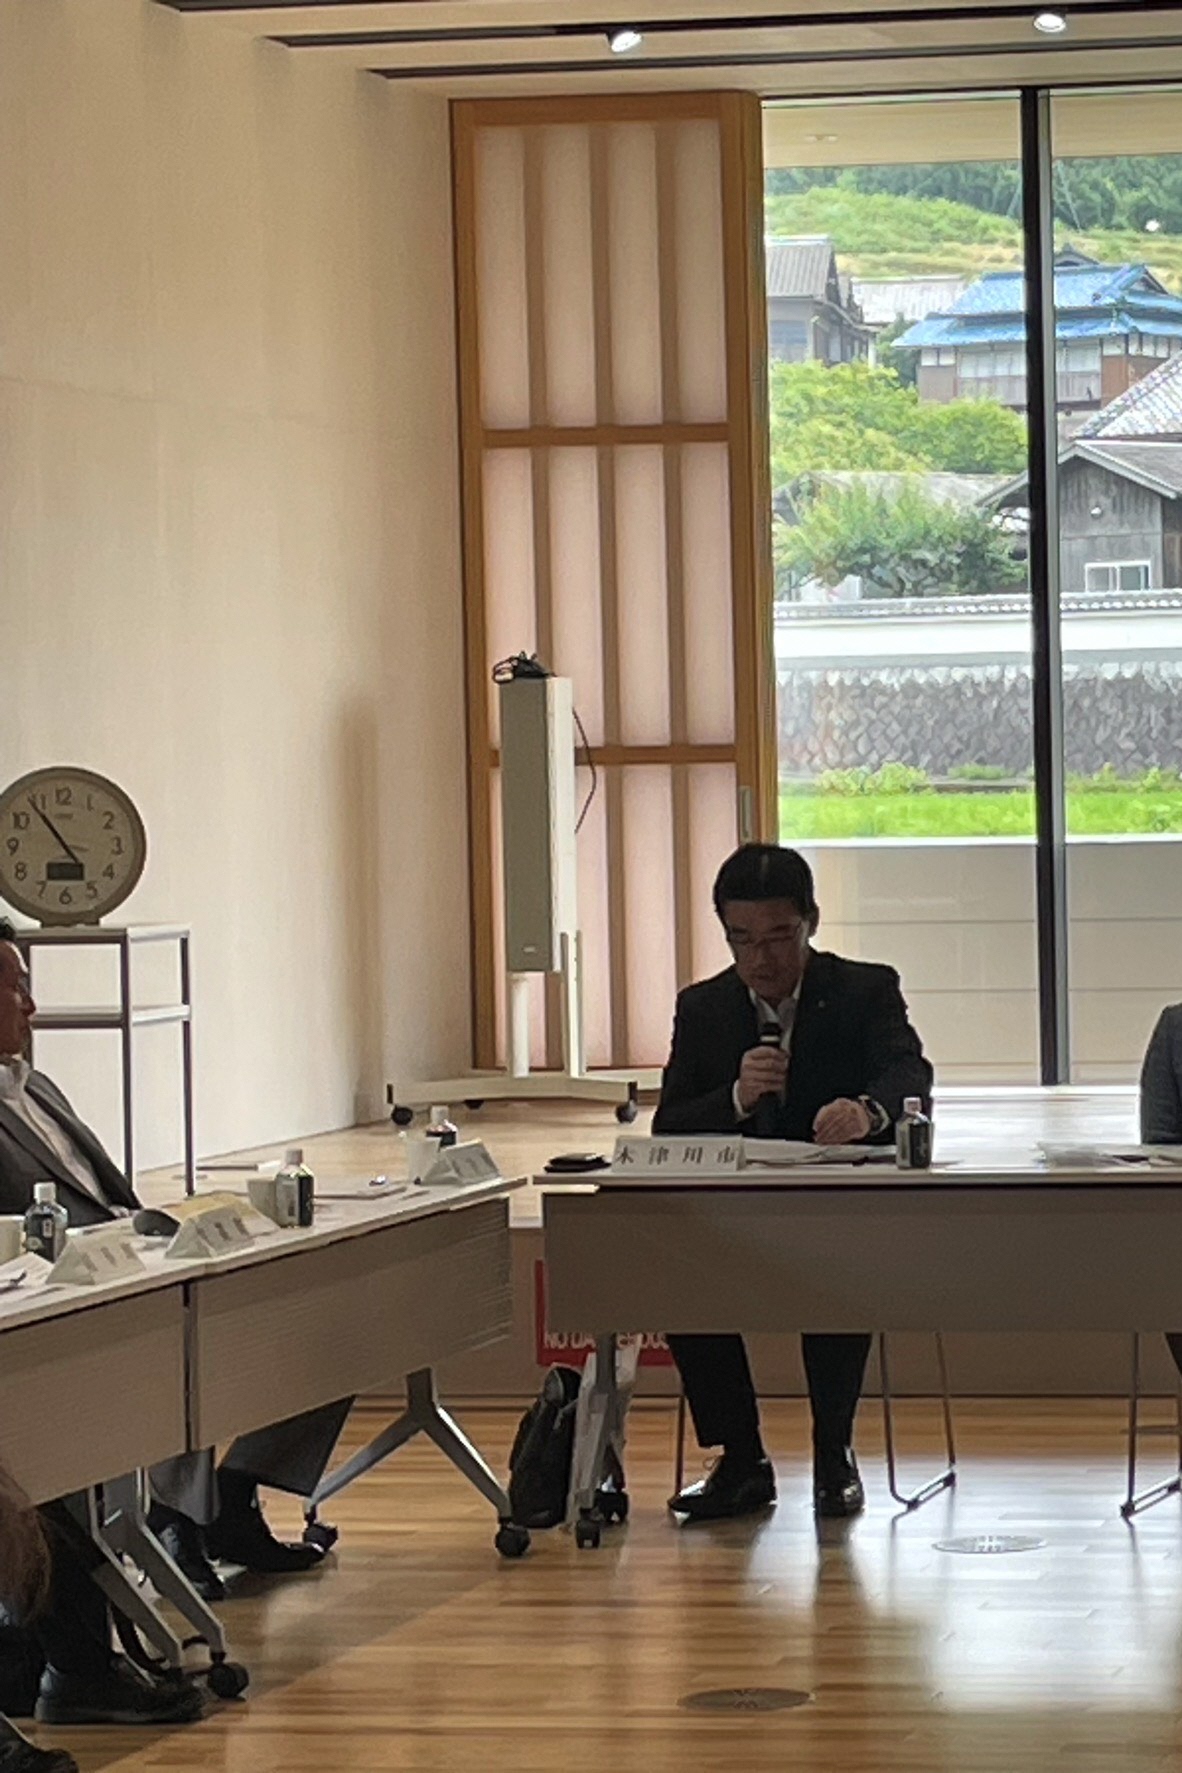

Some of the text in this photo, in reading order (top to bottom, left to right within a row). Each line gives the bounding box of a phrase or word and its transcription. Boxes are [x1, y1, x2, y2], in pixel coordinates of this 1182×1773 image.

[55, 787, 71, 805] 12
[86, 794, 94, 811] 1
[13, 811, 30, 830] 10
[102, 811, 114, 829] 2
[6, 837, 19, 856] 9
[111, 836, 123, 855] 3
[14, 862, 27, 881] 8
[102, 863, 115, 880] 4
[35, 881, 47, 898] 7
[59, 887, 72, 905] 6
[85, 881, 98, 899] 5
[615, 1145, 736, 1165] 木津川市
